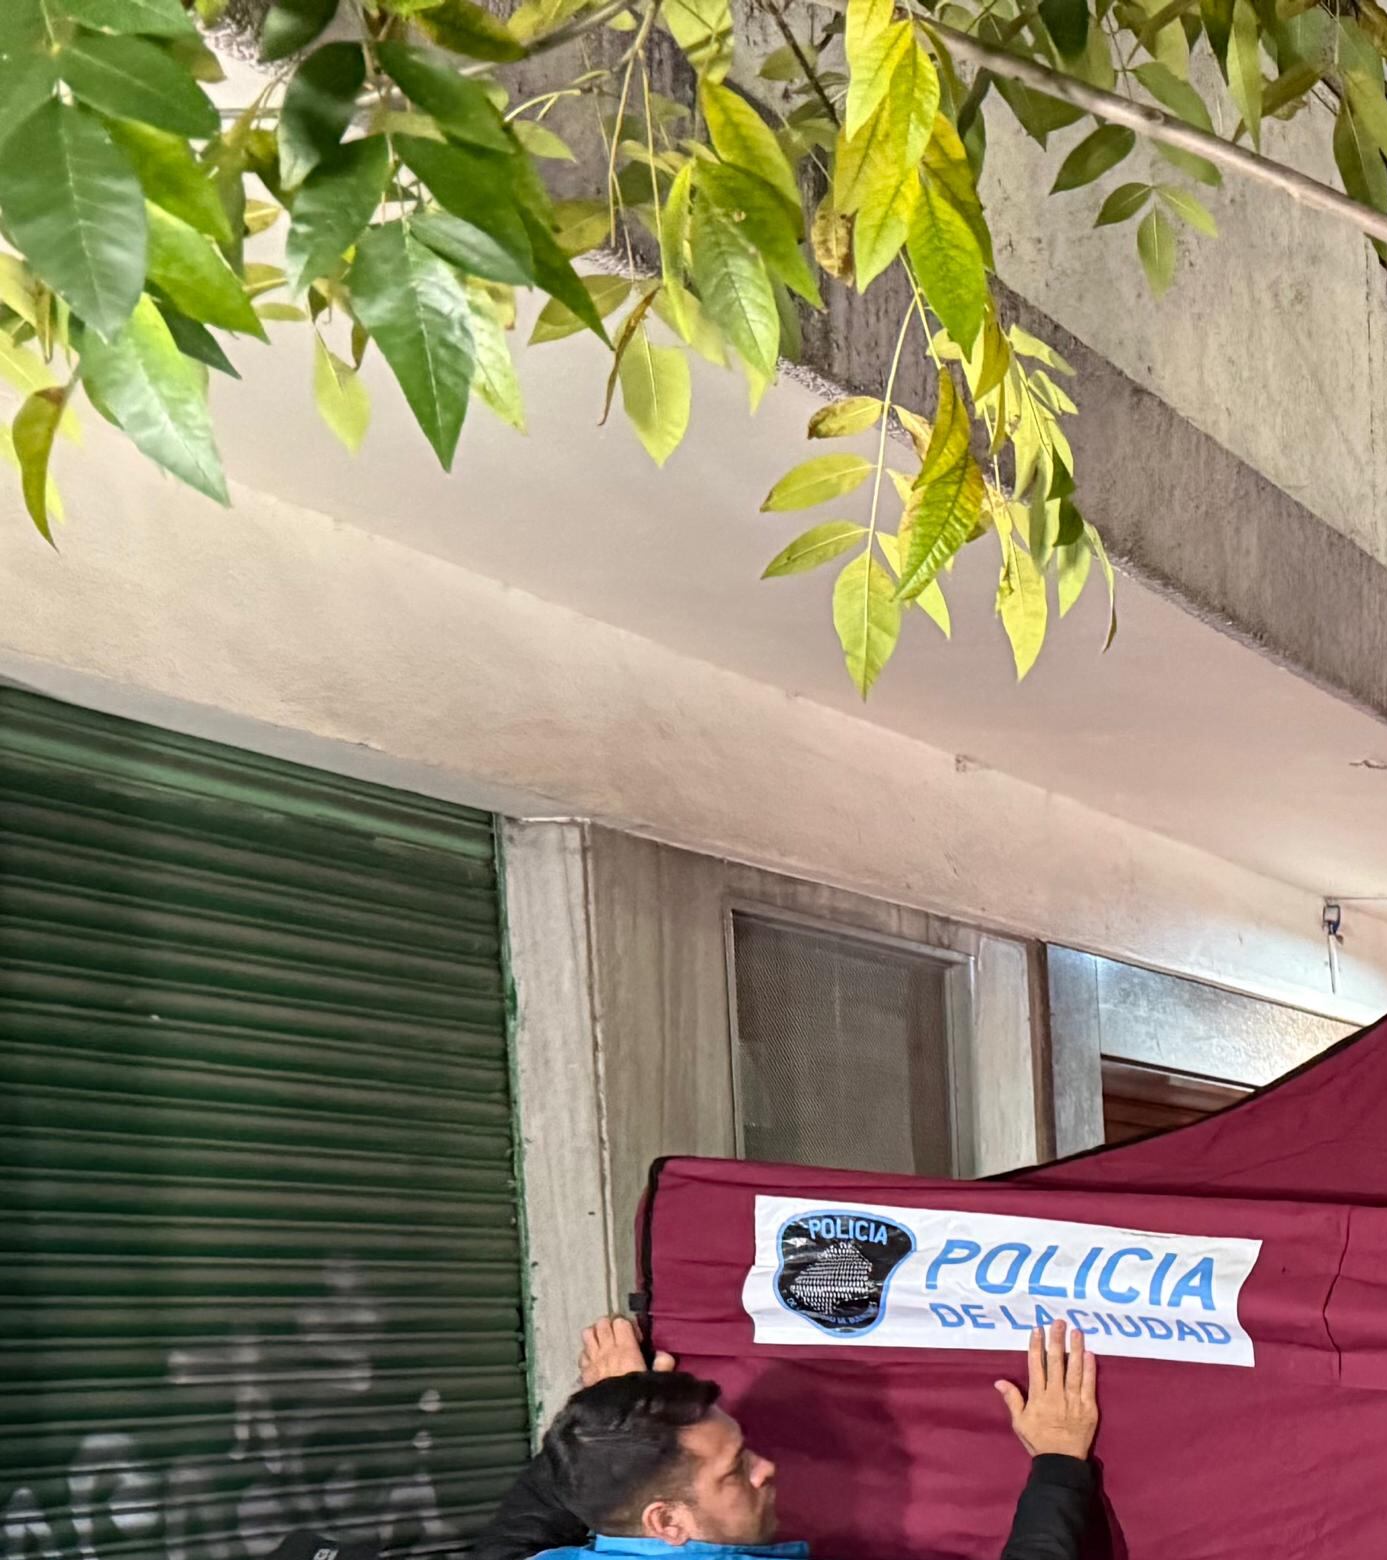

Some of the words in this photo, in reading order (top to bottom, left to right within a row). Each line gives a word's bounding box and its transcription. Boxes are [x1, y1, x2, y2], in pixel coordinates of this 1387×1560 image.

[808, 1218, 888, 1245] POLICIA
[925, 1239, 1216, 1311] POLICIA
[929, 1303, 996, 1329] DE
[1000, 1304, 1054, 1330] LA
[1066, 1308, 1232, 1344] CIUDAD
